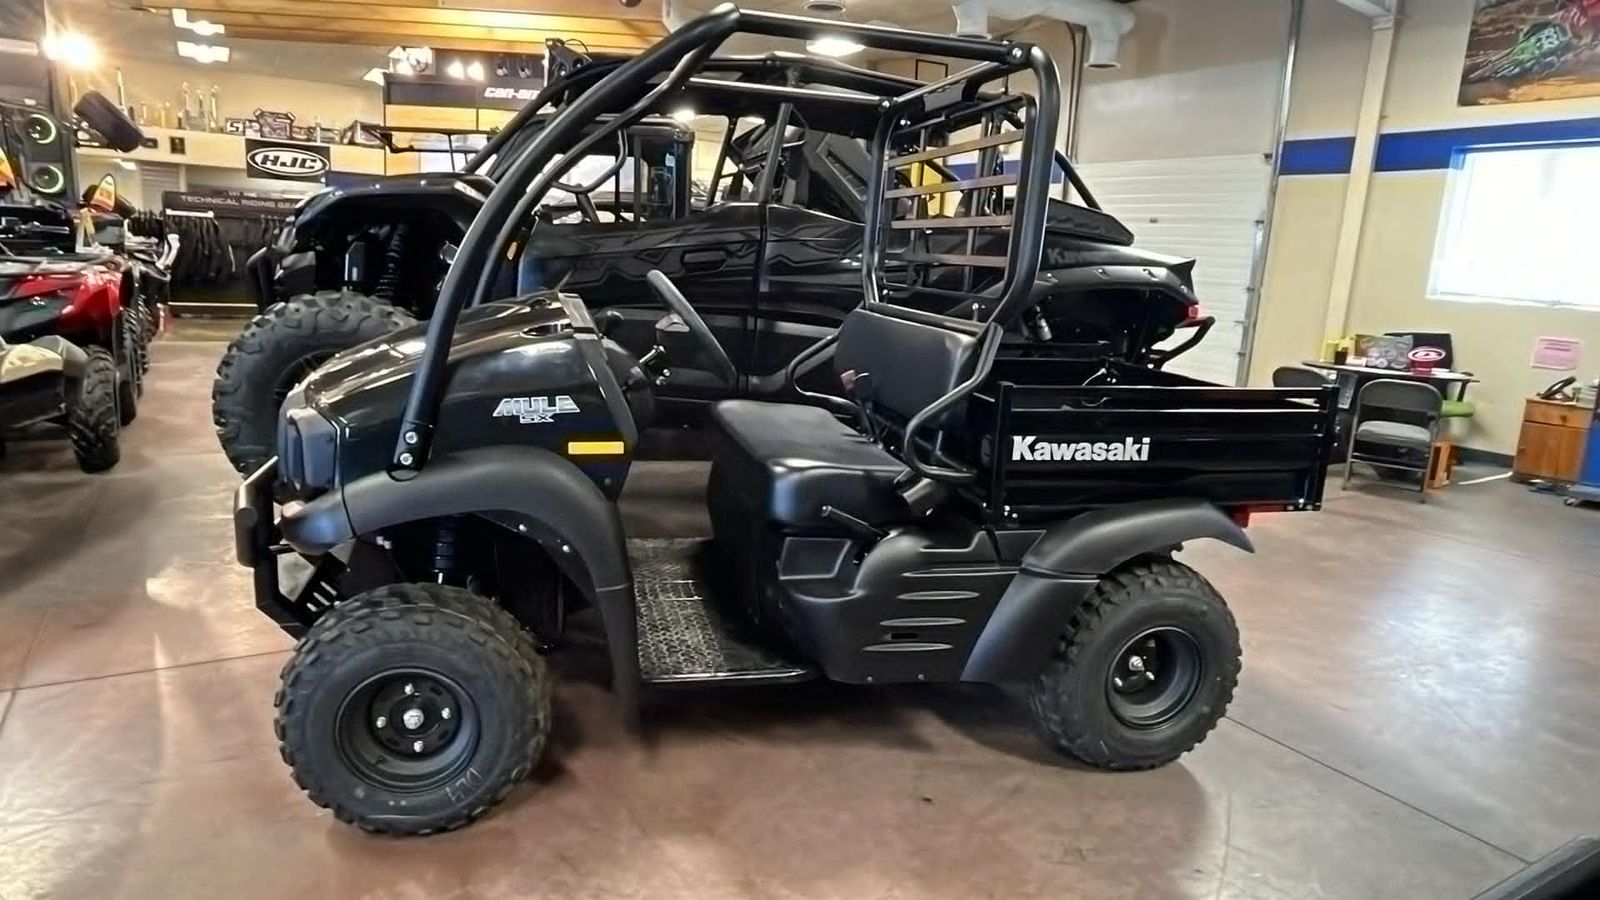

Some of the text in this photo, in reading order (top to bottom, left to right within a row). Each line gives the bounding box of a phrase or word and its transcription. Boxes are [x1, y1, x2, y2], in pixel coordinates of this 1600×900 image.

[260, 154, 317, 170] HJC
[180, 194, 240, 206] TECHNICAL
[492, 395, 581, 417] MULE
[520, 412, 555, 424] SX
[1011, 435, 1151, 461] Kawasaki
